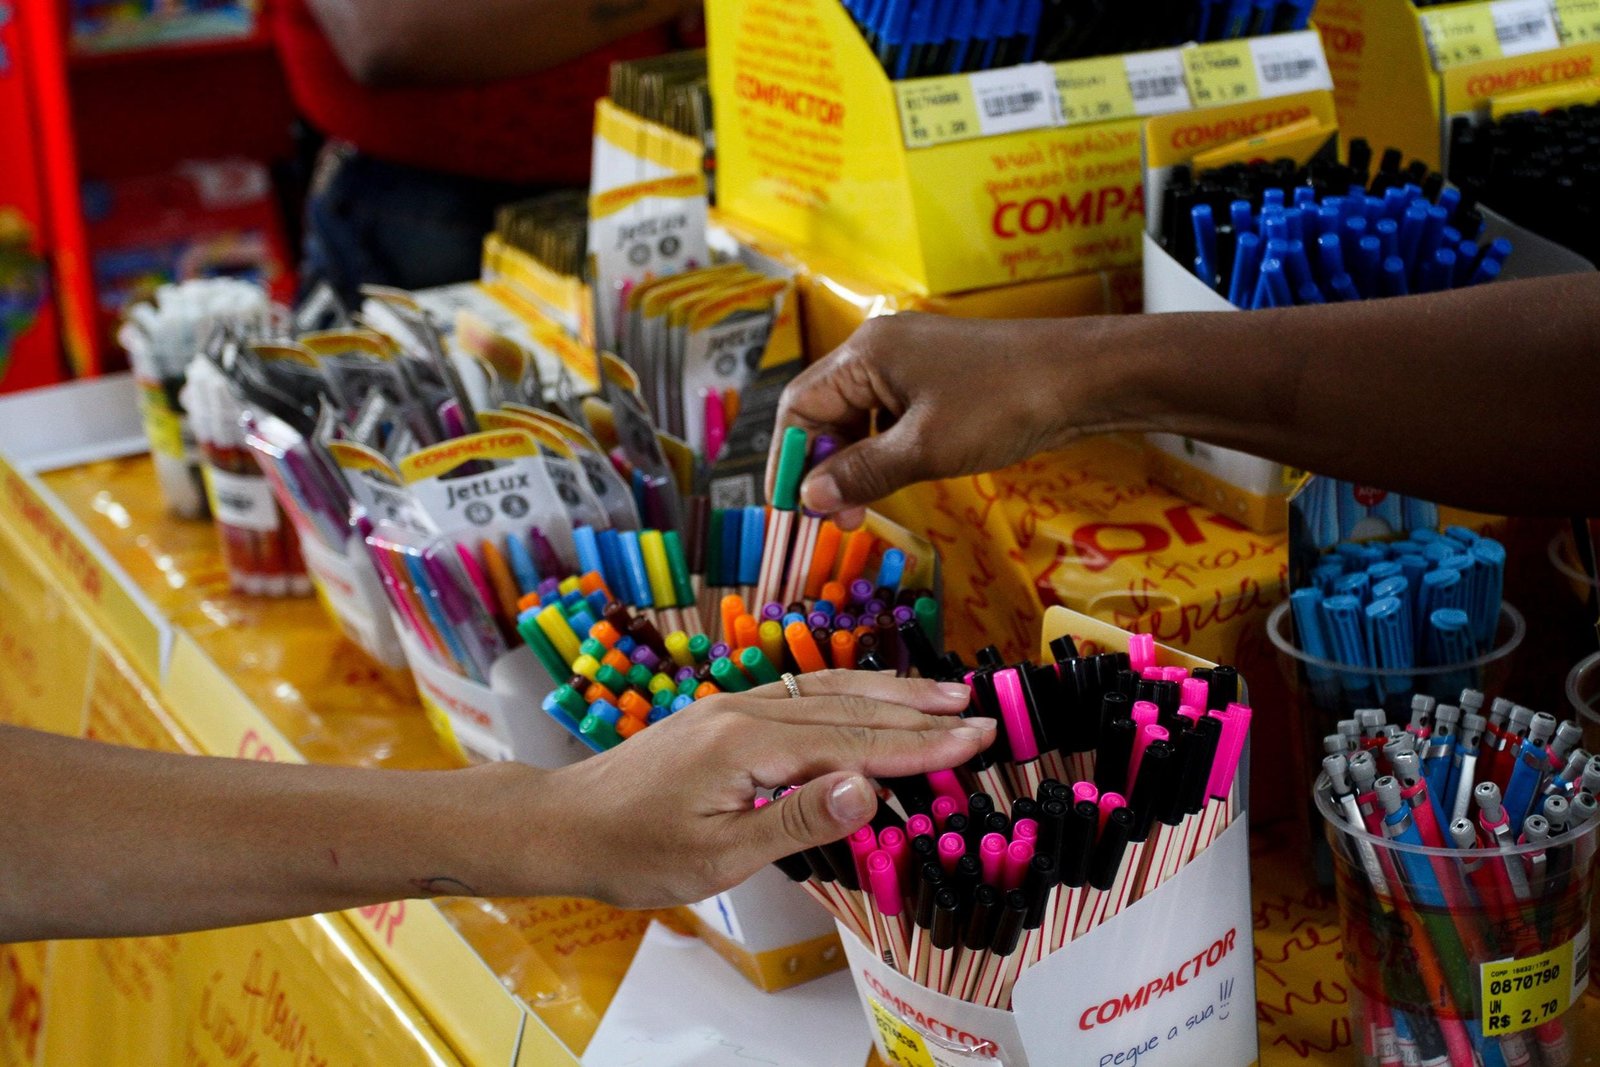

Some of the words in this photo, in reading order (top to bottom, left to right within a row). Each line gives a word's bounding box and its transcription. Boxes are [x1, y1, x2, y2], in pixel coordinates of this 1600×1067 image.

[1467, 56, 1593, 97] COMPACTOR
[413, 434, 526, 469] COMPACTOR
[447, 472, 531, 509] JetLux
[1078, 927, 1236, 1031] COMPACTOR
[1490, 964, 1560, 996] 0870790
[863, 968, 999, 1058] COMPACTOR
[1488, 1013, 1511, 1031] R$
[1520, 998, 1559, 1025] 2,70
[1489, 999, 1502, 1015] UN
[1099, 1036, 1159, 1067] Pegue
[1167, 1026, 1178, 1041] a
[1185, 1004, 1215, 1030] sua
